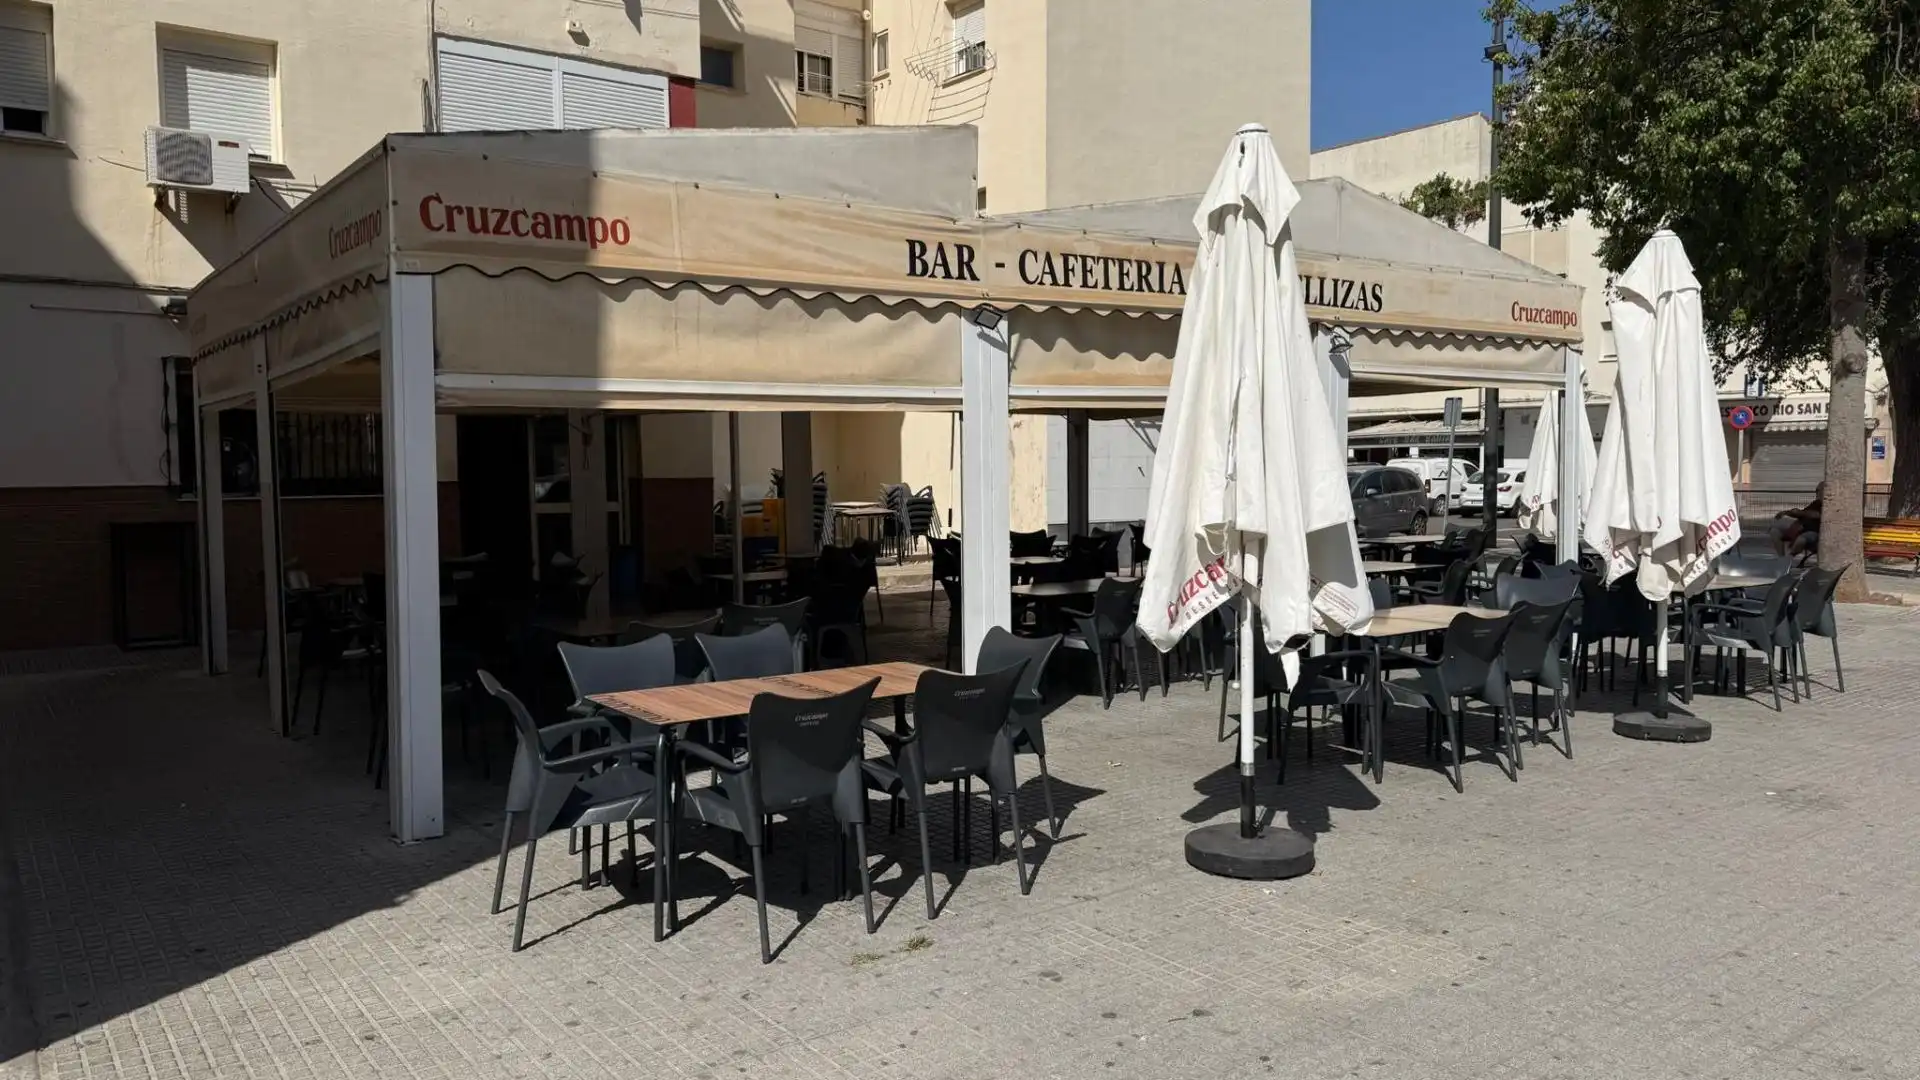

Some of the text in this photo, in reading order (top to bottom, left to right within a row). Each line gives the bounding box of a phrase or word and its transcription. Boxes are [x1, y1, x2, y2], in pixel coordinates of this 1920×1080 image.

[328, 209, 381, 259] Cruzcampo
[419, 193, 630, 249] Cruzcampo
[905, 239, 980, 282] BAR
[1017, 248, 1187, 295] CAFETERIA
[1298, 274, 1383, 313] LLIZAS
[1511, 300, 1577, 329] Cruzcampo
[1797, 402, 1821, 415] SAN
